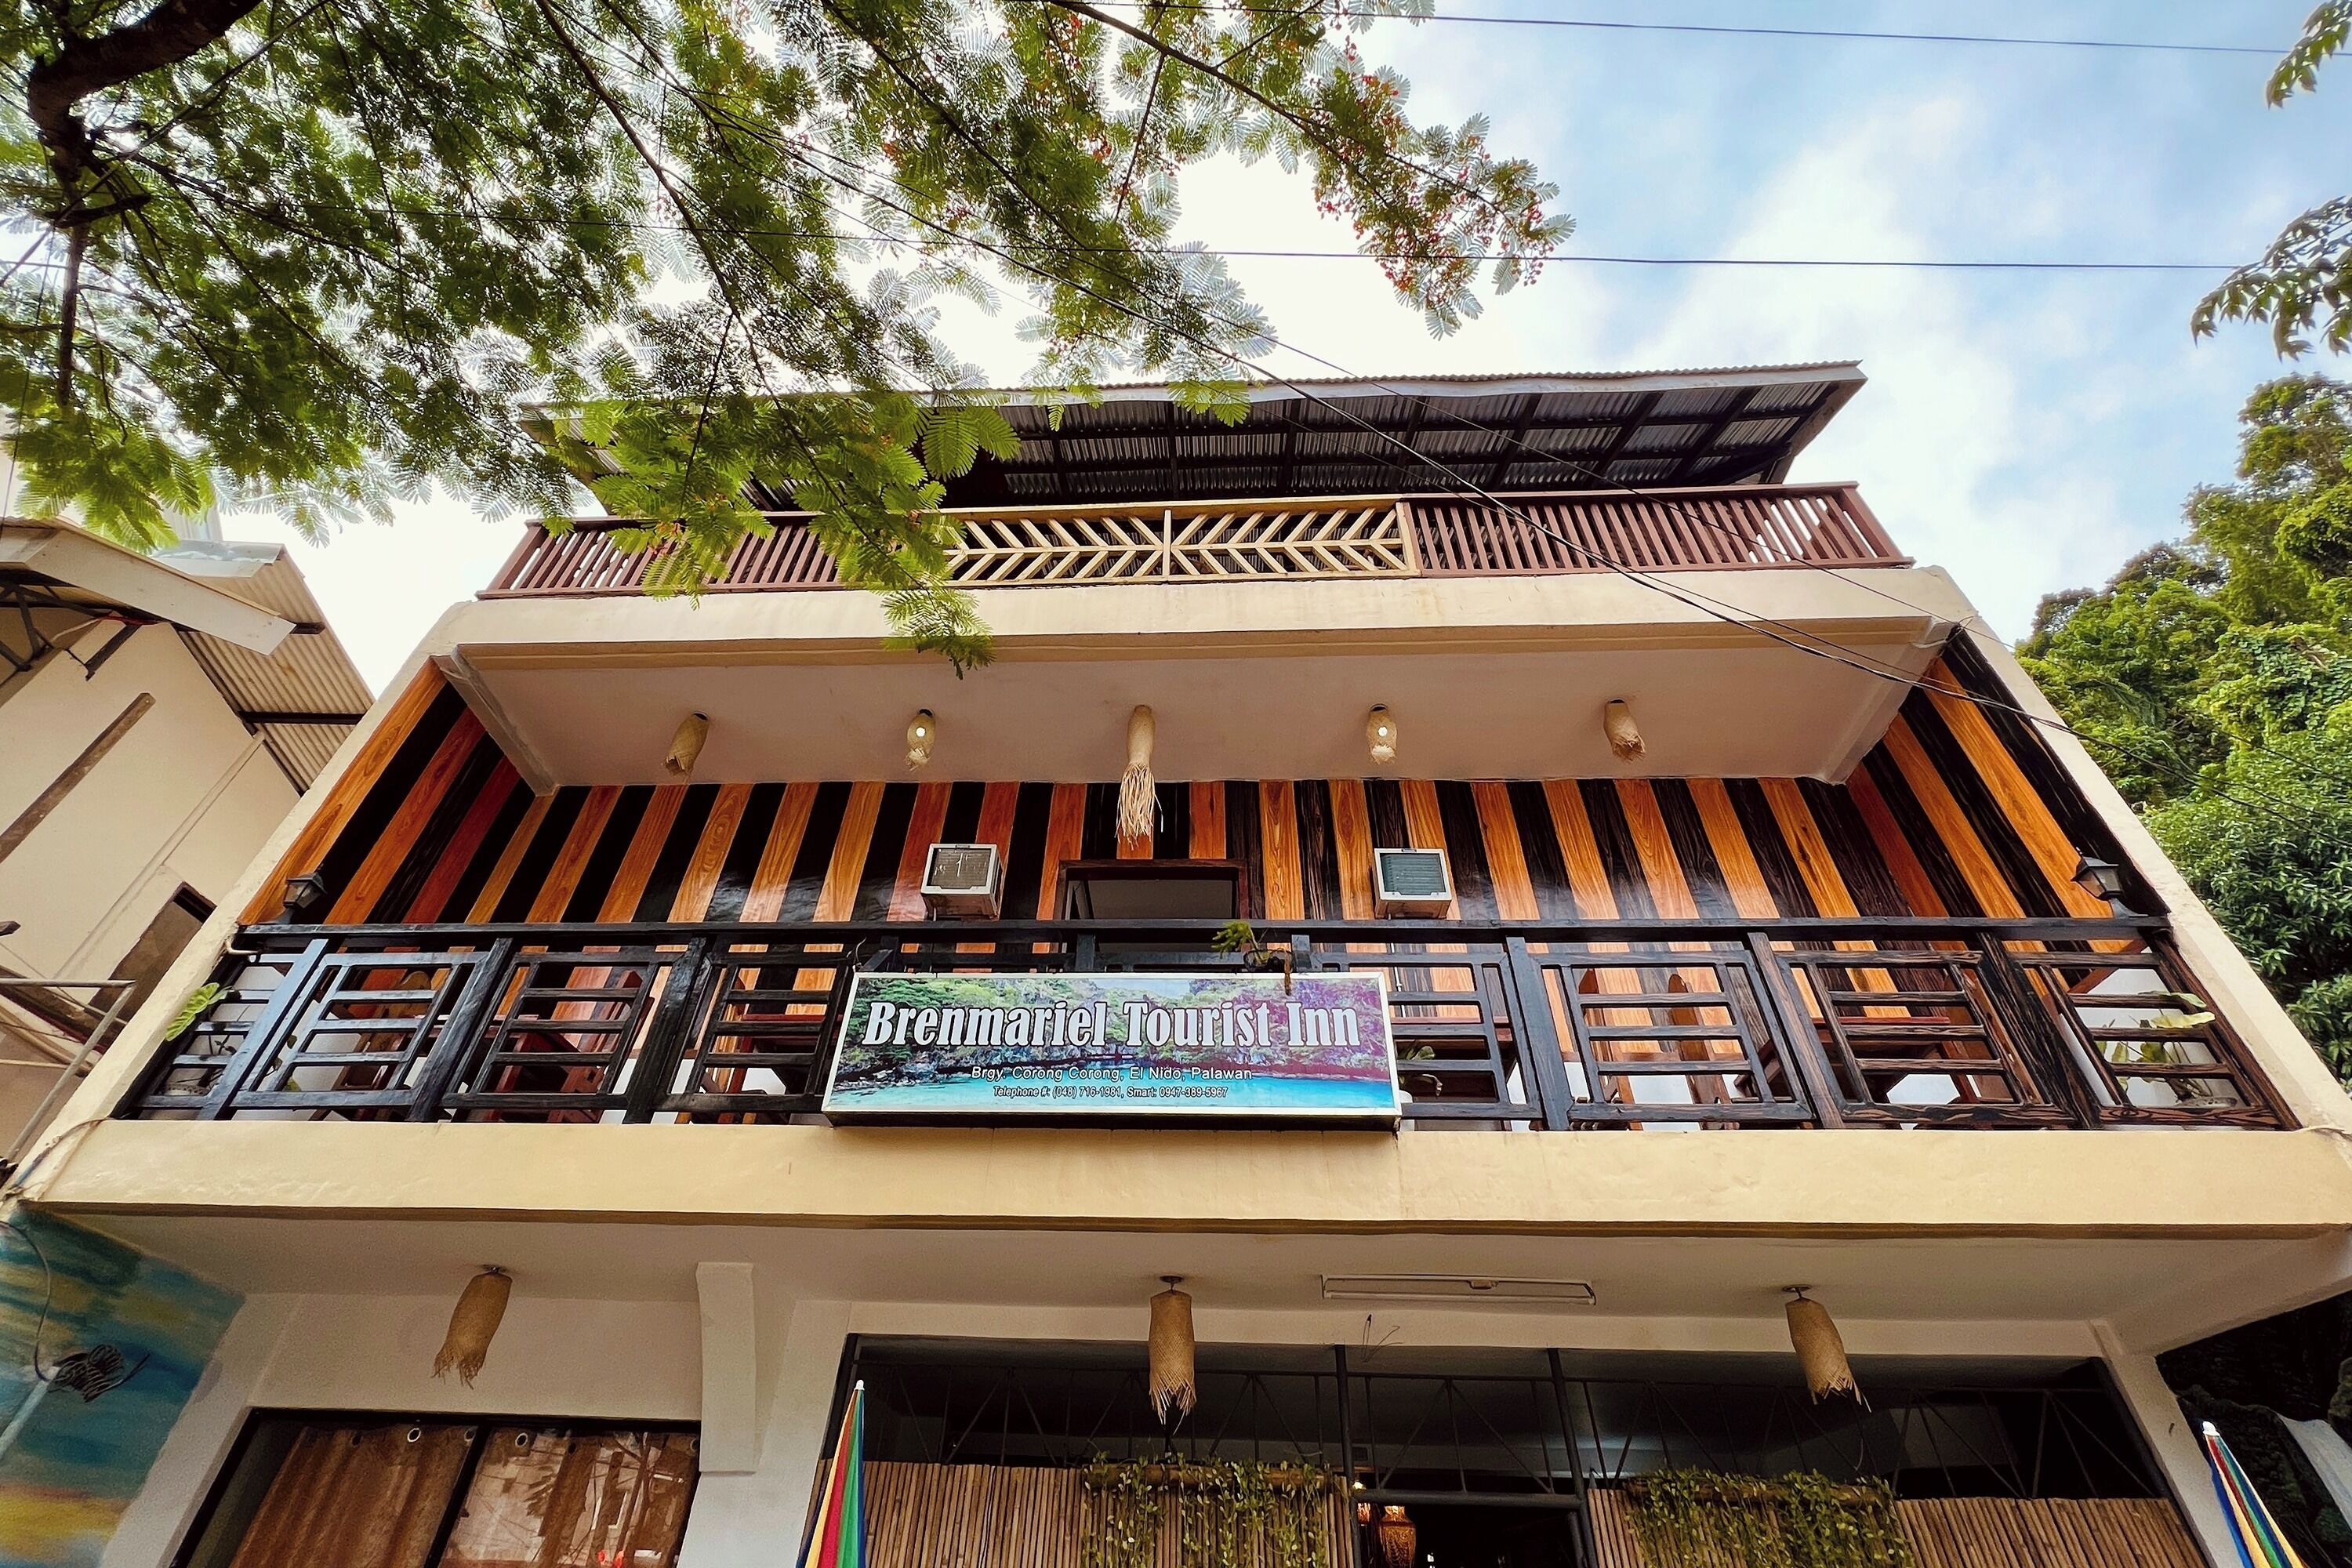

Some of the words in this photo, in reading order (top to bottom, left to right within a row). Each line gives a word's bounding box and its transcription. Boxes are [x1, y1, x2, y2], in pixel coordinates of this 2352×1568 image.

[862, 1002, 1107, 1046] Brenmariel
[1123, 1002, 1271, 1047] Tourist
[1287, 1002, 1360, 1047] Inn
[971, 1066, 1006, 1081] Brgy.
[1012, 1066, 1063, 1082] Corong
[1069, 1066, 1123, 1082] Corong,
[1130, 1067, 1143, 1080] El
[1149, 1067, 1185, 1080] Nido,
[1191, 1067, 1253, 1080] Palawan
[994, 1086, 1039, 1098] Telephone
[1052, 1087, 1076, 1098] (048)
[1079, 1087, 1123, 1098] 716-1981,
[1127, 1087, 1157, 1097] Smart:
[1160, 1087, 1228, 1097] 0947-389-5967
